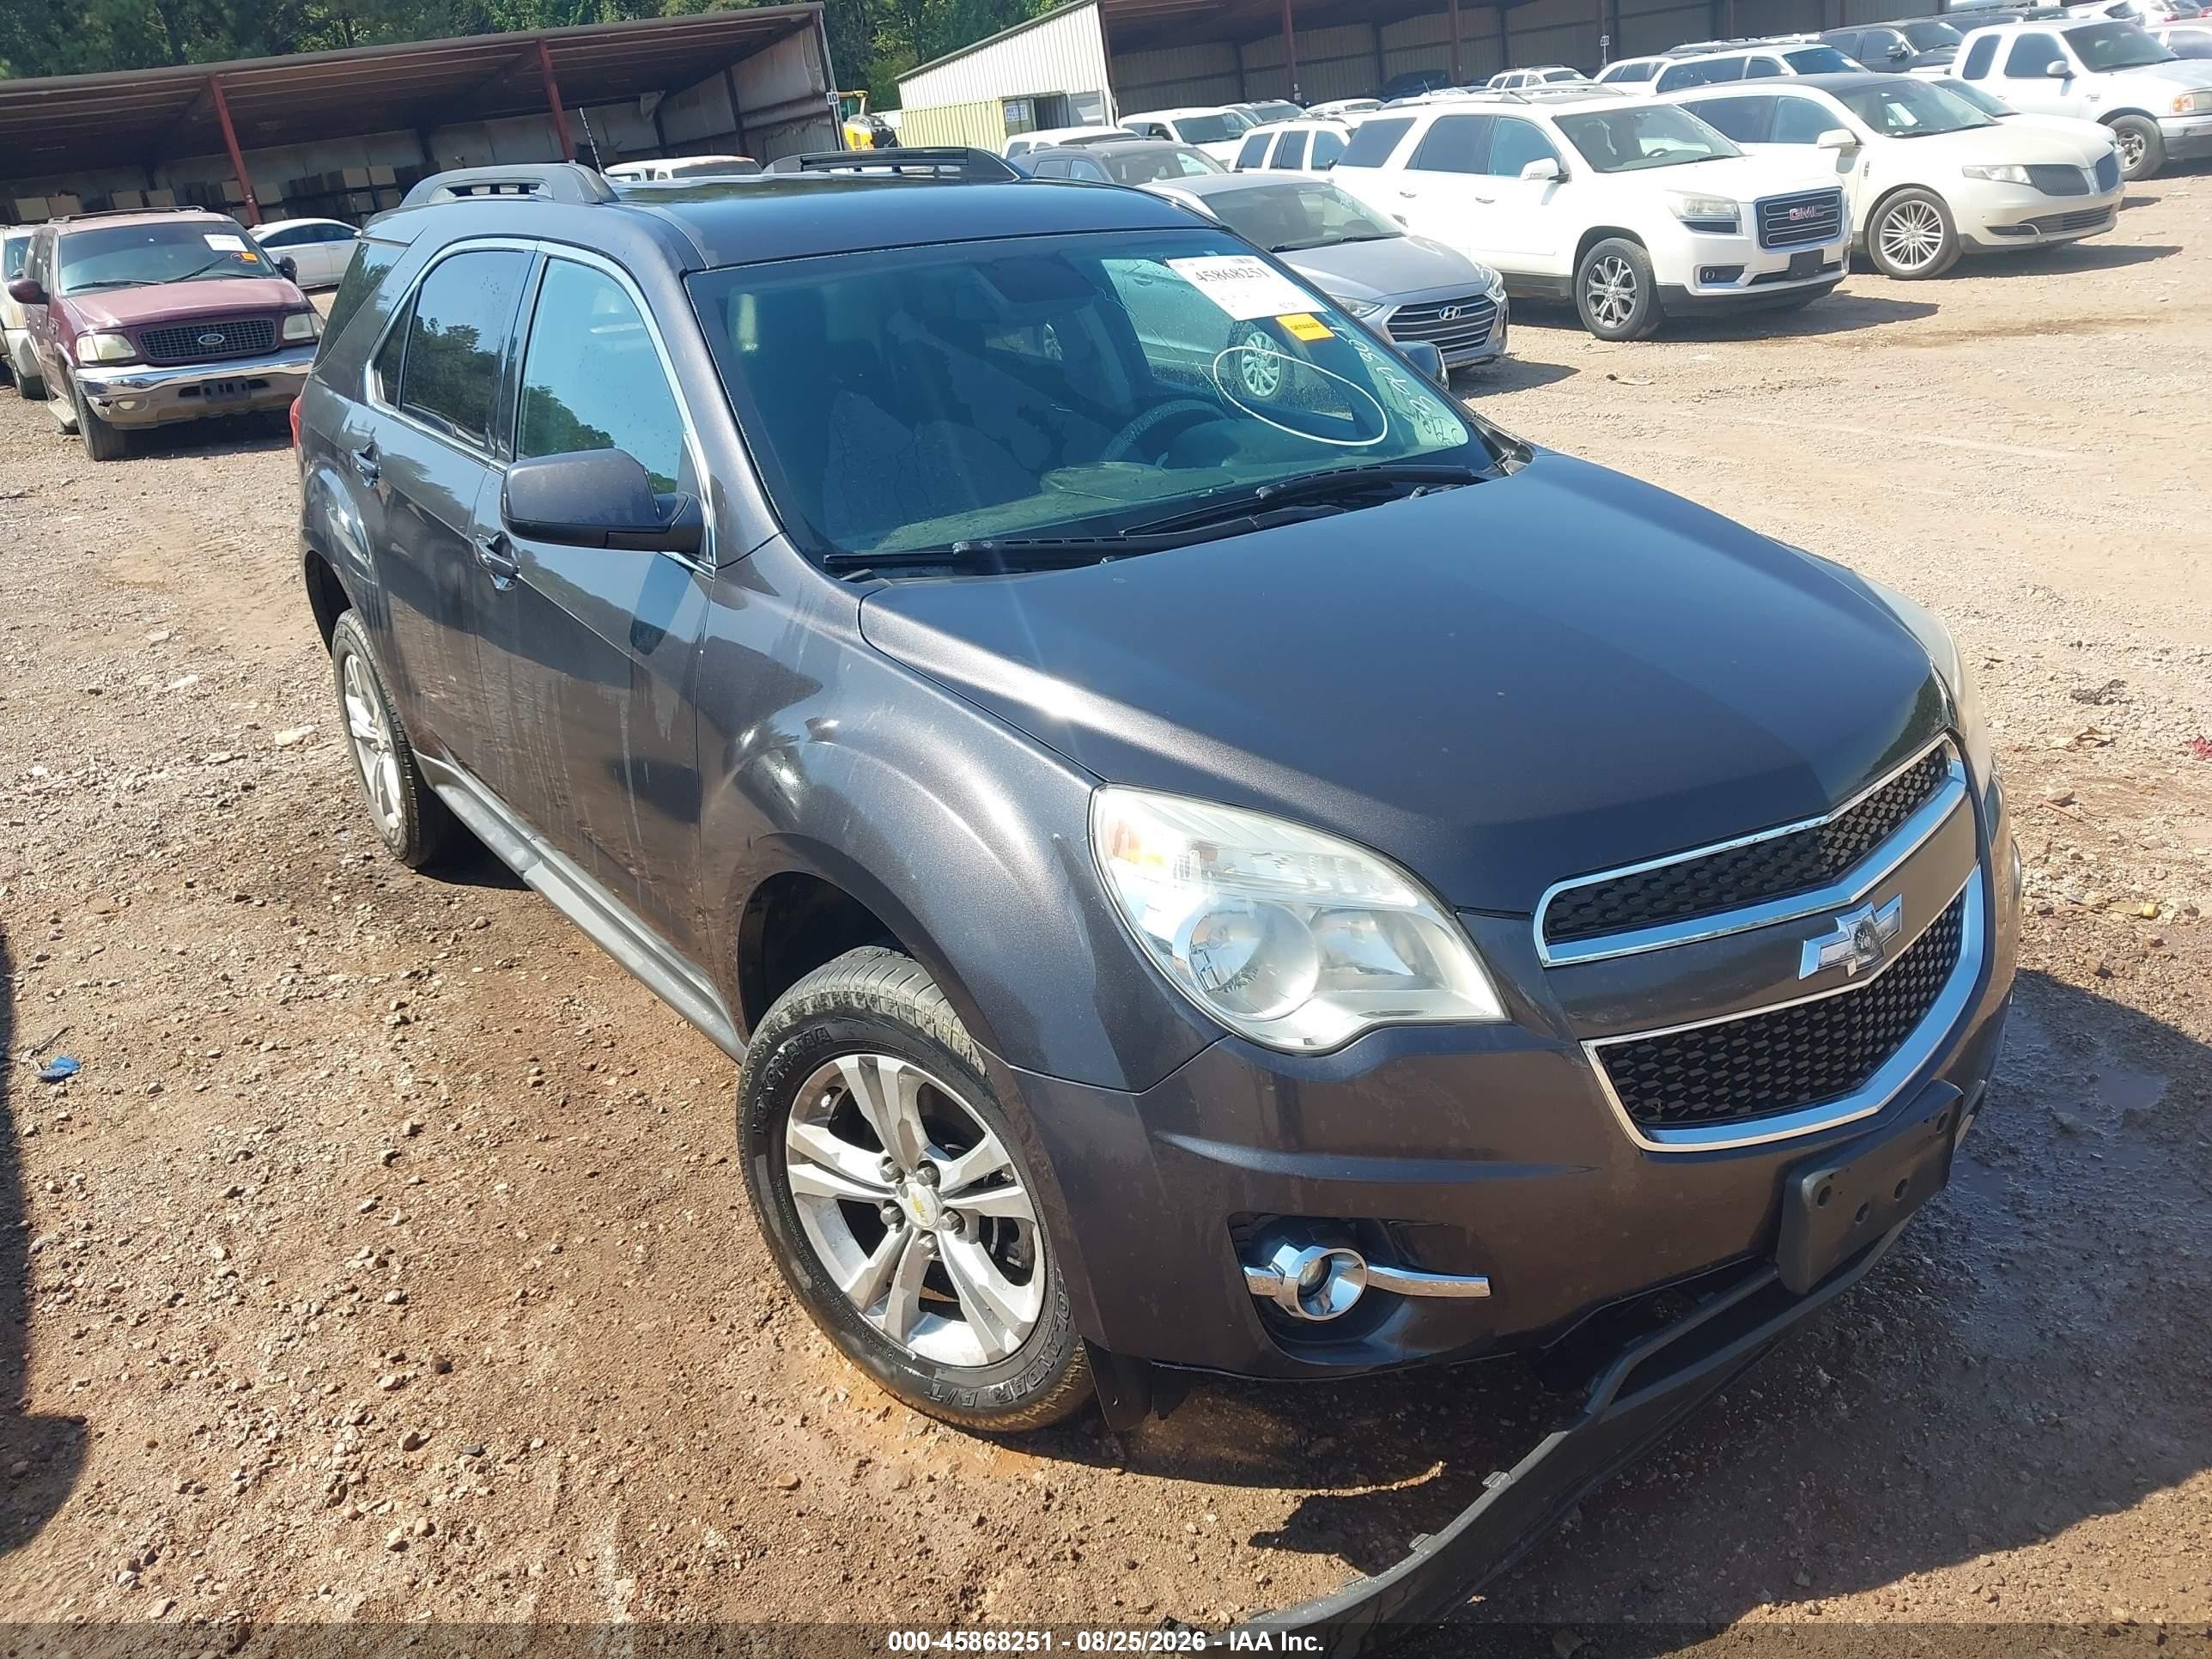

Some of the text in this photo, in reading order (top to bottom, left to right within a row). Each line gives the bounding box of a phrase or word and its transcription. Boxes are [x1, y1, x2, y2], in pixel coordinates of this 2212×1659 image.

[829, 94, 837, 102] 10
[1789, 204, 1825, 221] GMC
[1194, 266, 1271, 282] 45868251
[994, 1269, 1071, 1403] EOLANDAR
